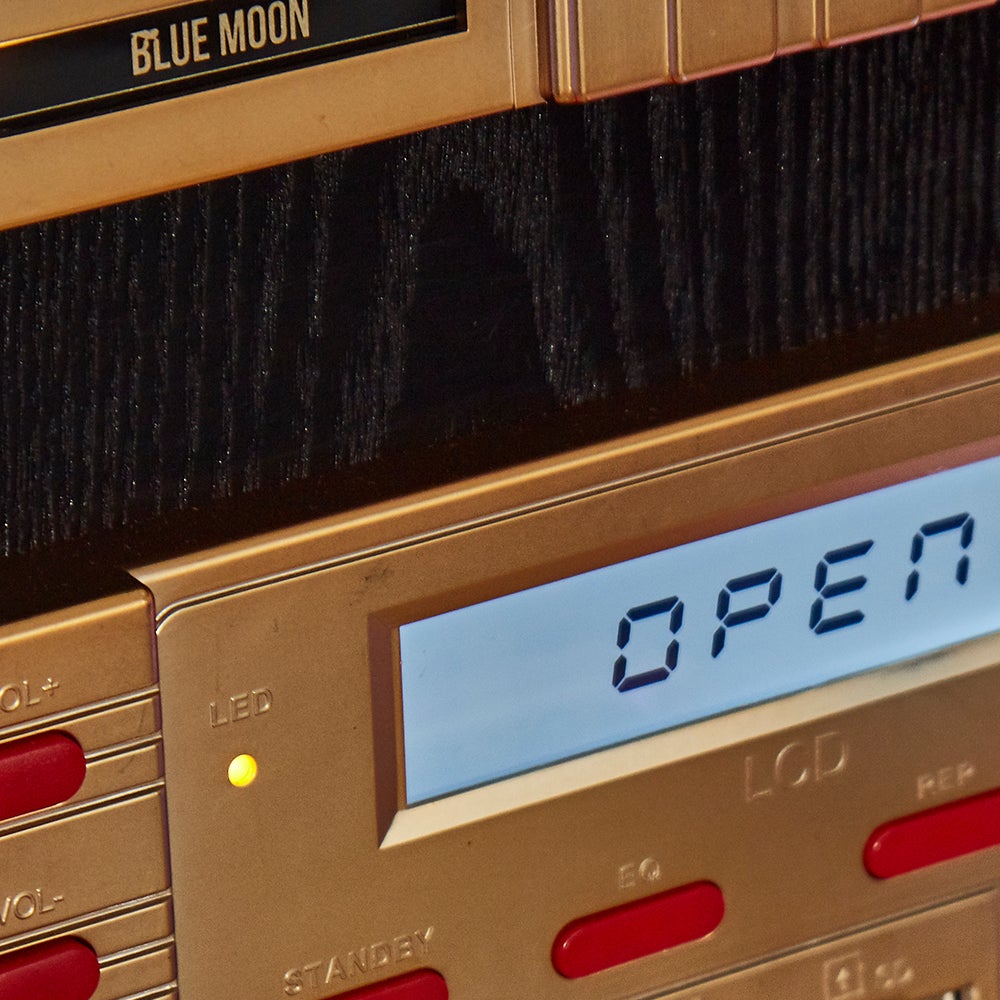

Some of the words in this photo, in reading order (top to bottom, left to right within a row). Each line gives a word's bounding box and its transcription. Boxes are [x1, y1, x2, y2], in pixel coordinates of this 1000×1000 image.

[131, 17, 210, 76] BLUE
[218, 0, 310, 56] MOON
[612, 511, 975, 693] OPEN
[0, 678, 60, 713] OL+
[209, 687, 273, 728] LED
[745, 731, 848, 803] LCD
[618, 857, 662, 889] EQ
[284, 926, 434, 996] STANDBY
